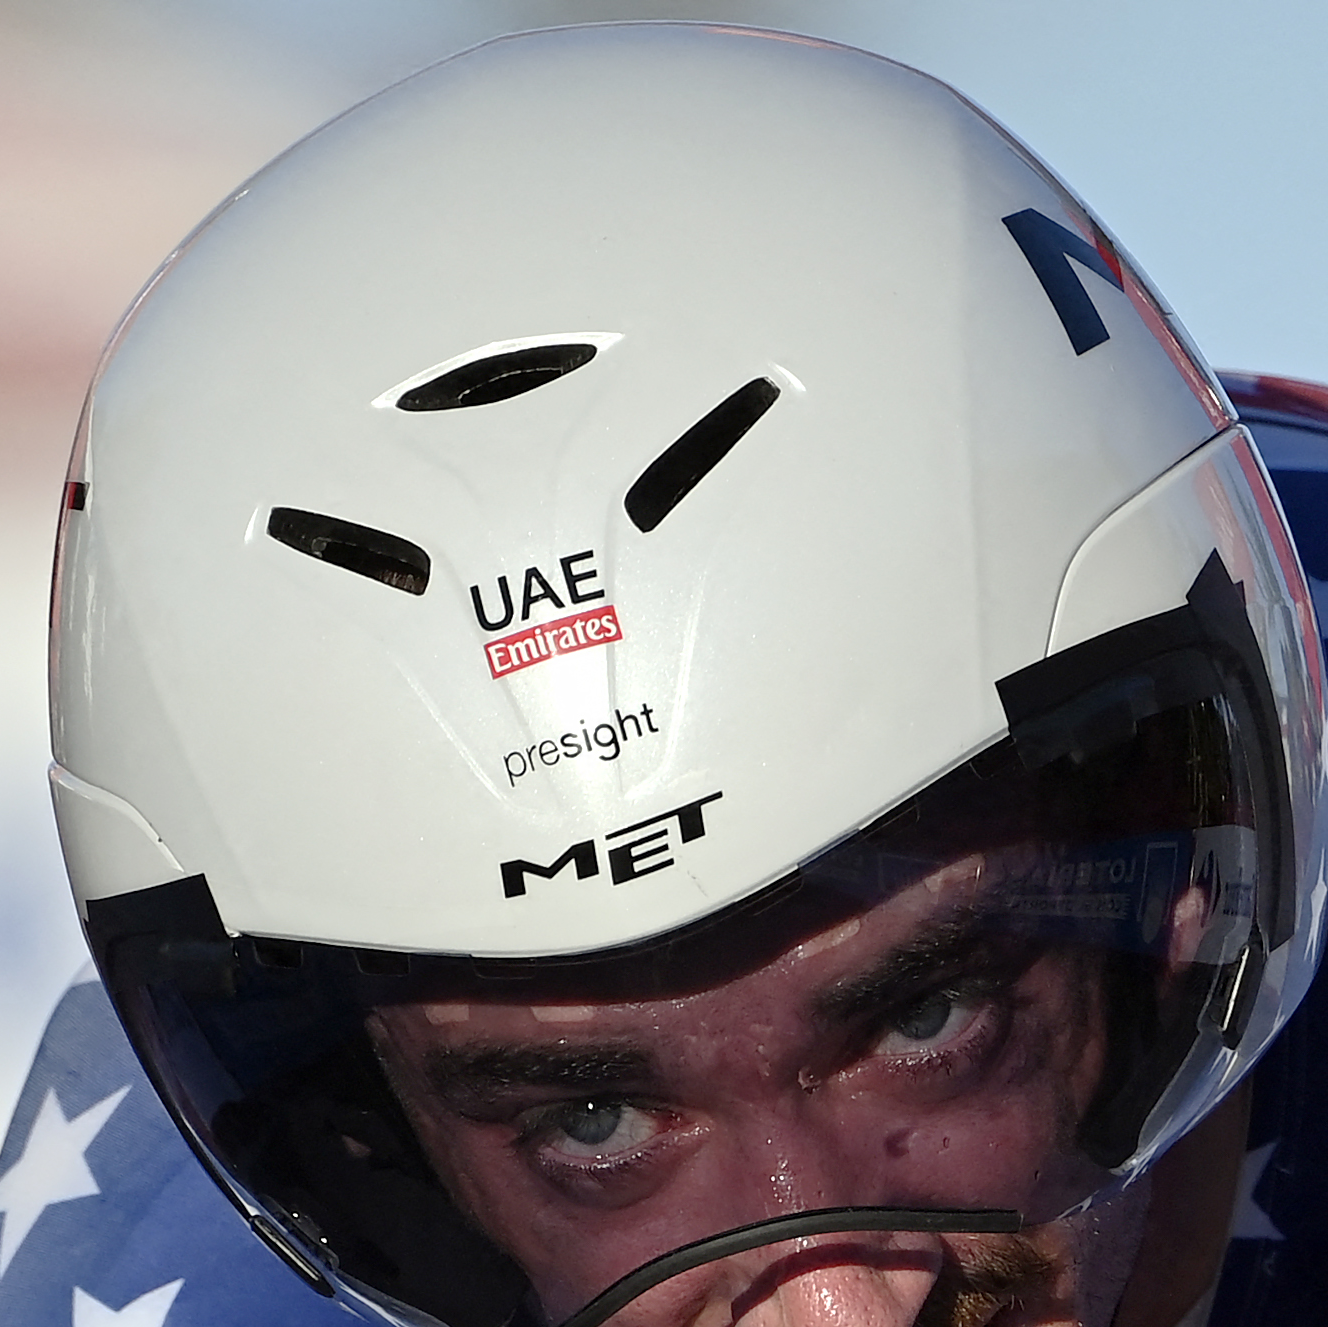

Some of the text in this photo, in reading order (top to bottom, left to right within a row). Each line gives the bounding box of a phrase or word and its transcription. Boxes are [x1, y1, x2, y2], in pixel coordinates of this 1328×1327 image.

[470, 550, 606, 632] UAE
[486, 610, 619, 676] Emirates
[502, 703, 659, 788] presight
[500, 791, 724, 899] MET
